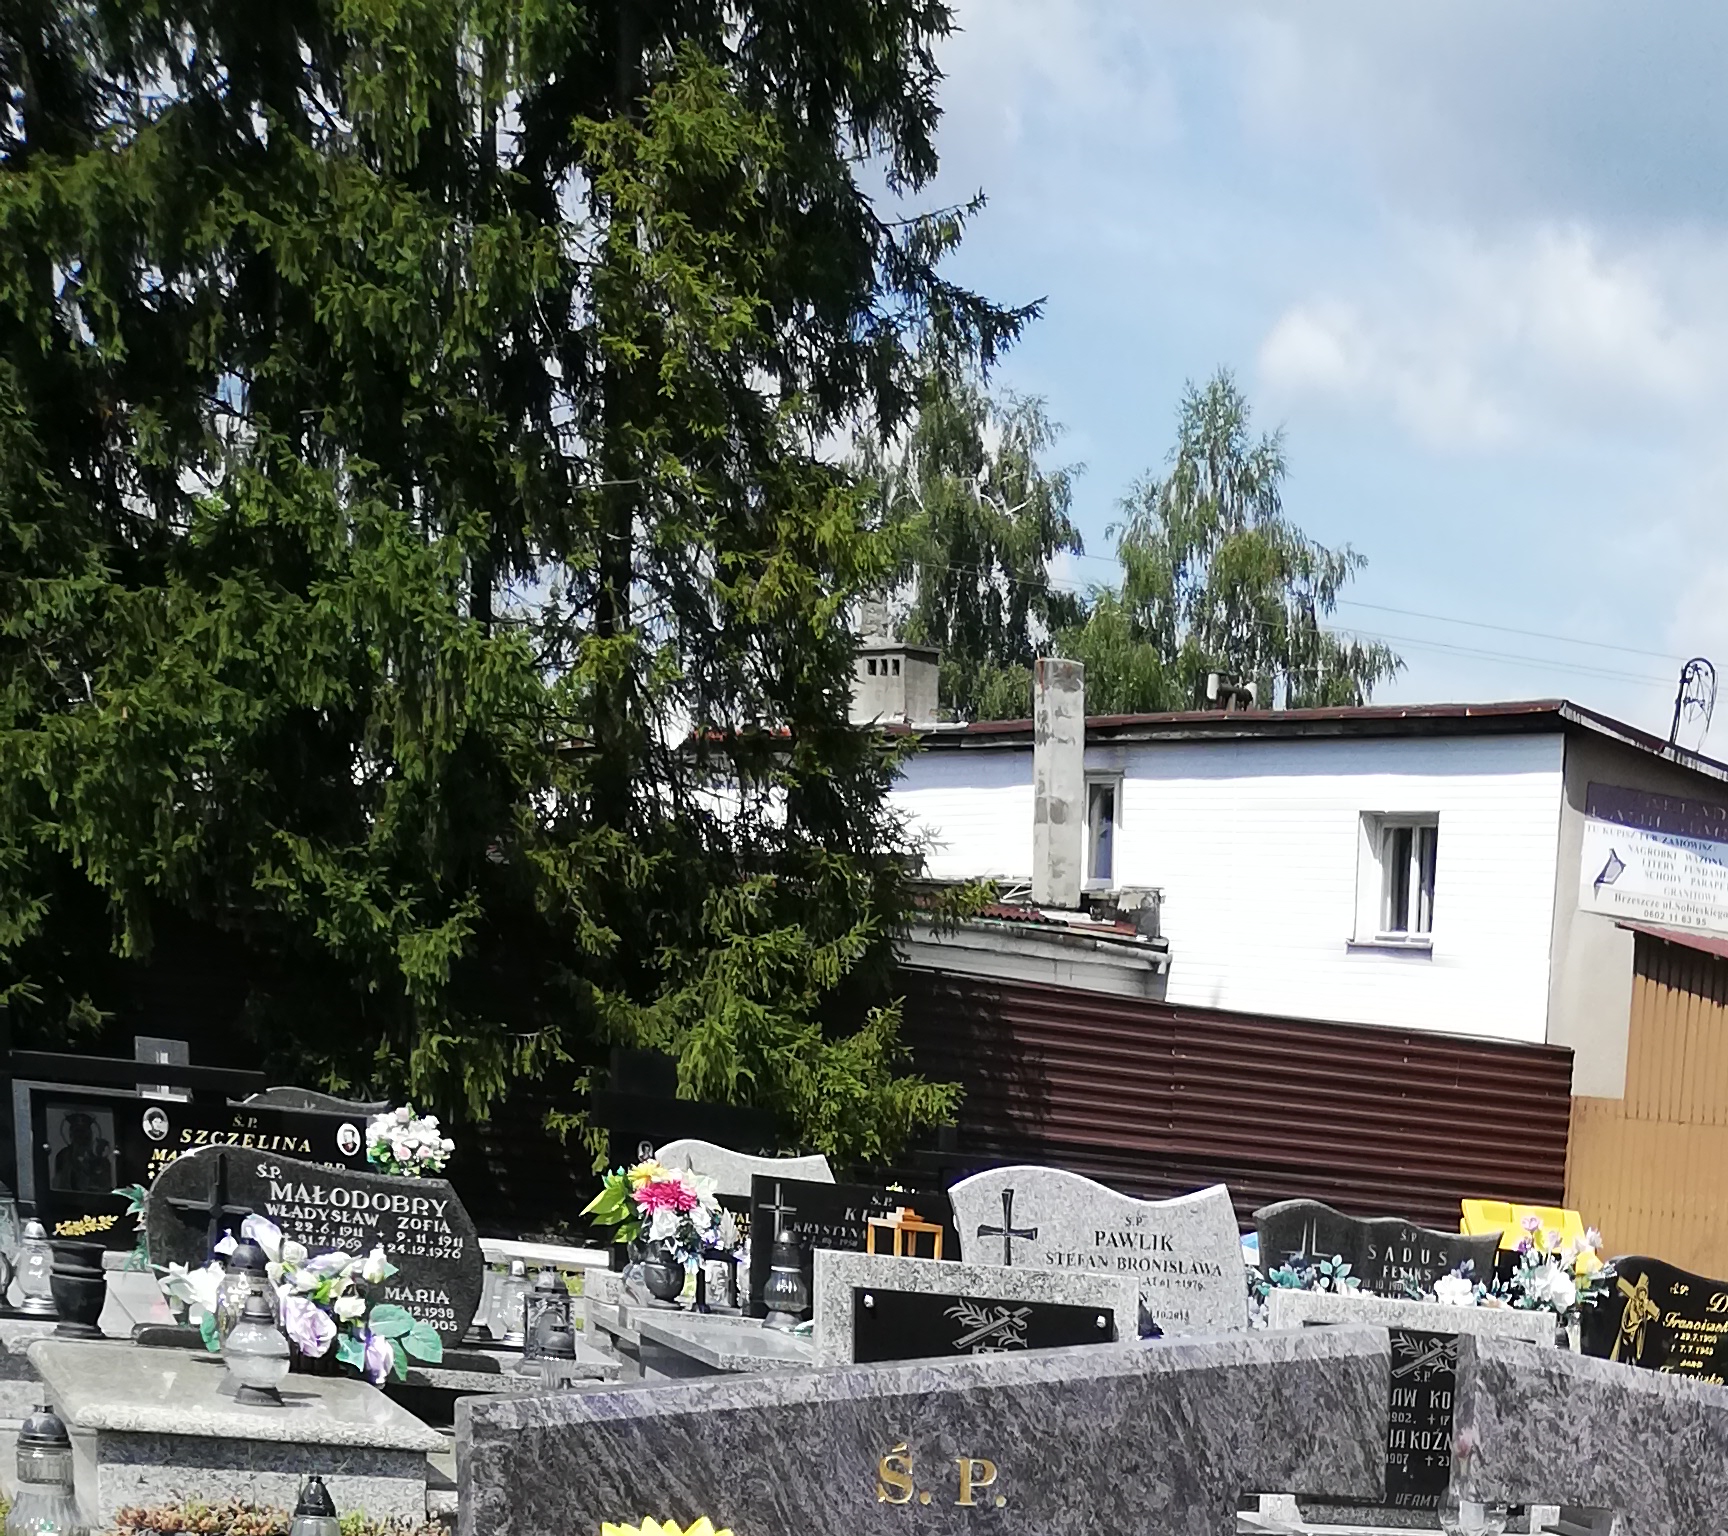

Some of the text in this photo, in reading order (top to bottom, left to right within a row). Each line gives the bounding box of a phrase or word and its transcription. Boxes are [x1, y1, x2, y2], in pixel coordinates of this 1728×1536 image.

[1627, 844, 1678, 861] NAGROBKI
[1644, 869, 1683, 883] SCHODY
[1614, 893, 1660, 909] Brzeszcze
[179, 1128, 312, 1153] SZCZELINA
[269, 1180, 449, 1218] MAŁODOBRY
[264, 1202, 452, 1234] WŁADYSŁAW ZOFIA
[1094, 1230, 1174, 1252] PAWLIK
[1045, 1252, 1109, 1268] STEFAN
[1367, 1243, 1449, 1267] SADUS
[384, 1286, 450, 1305] MARIA
